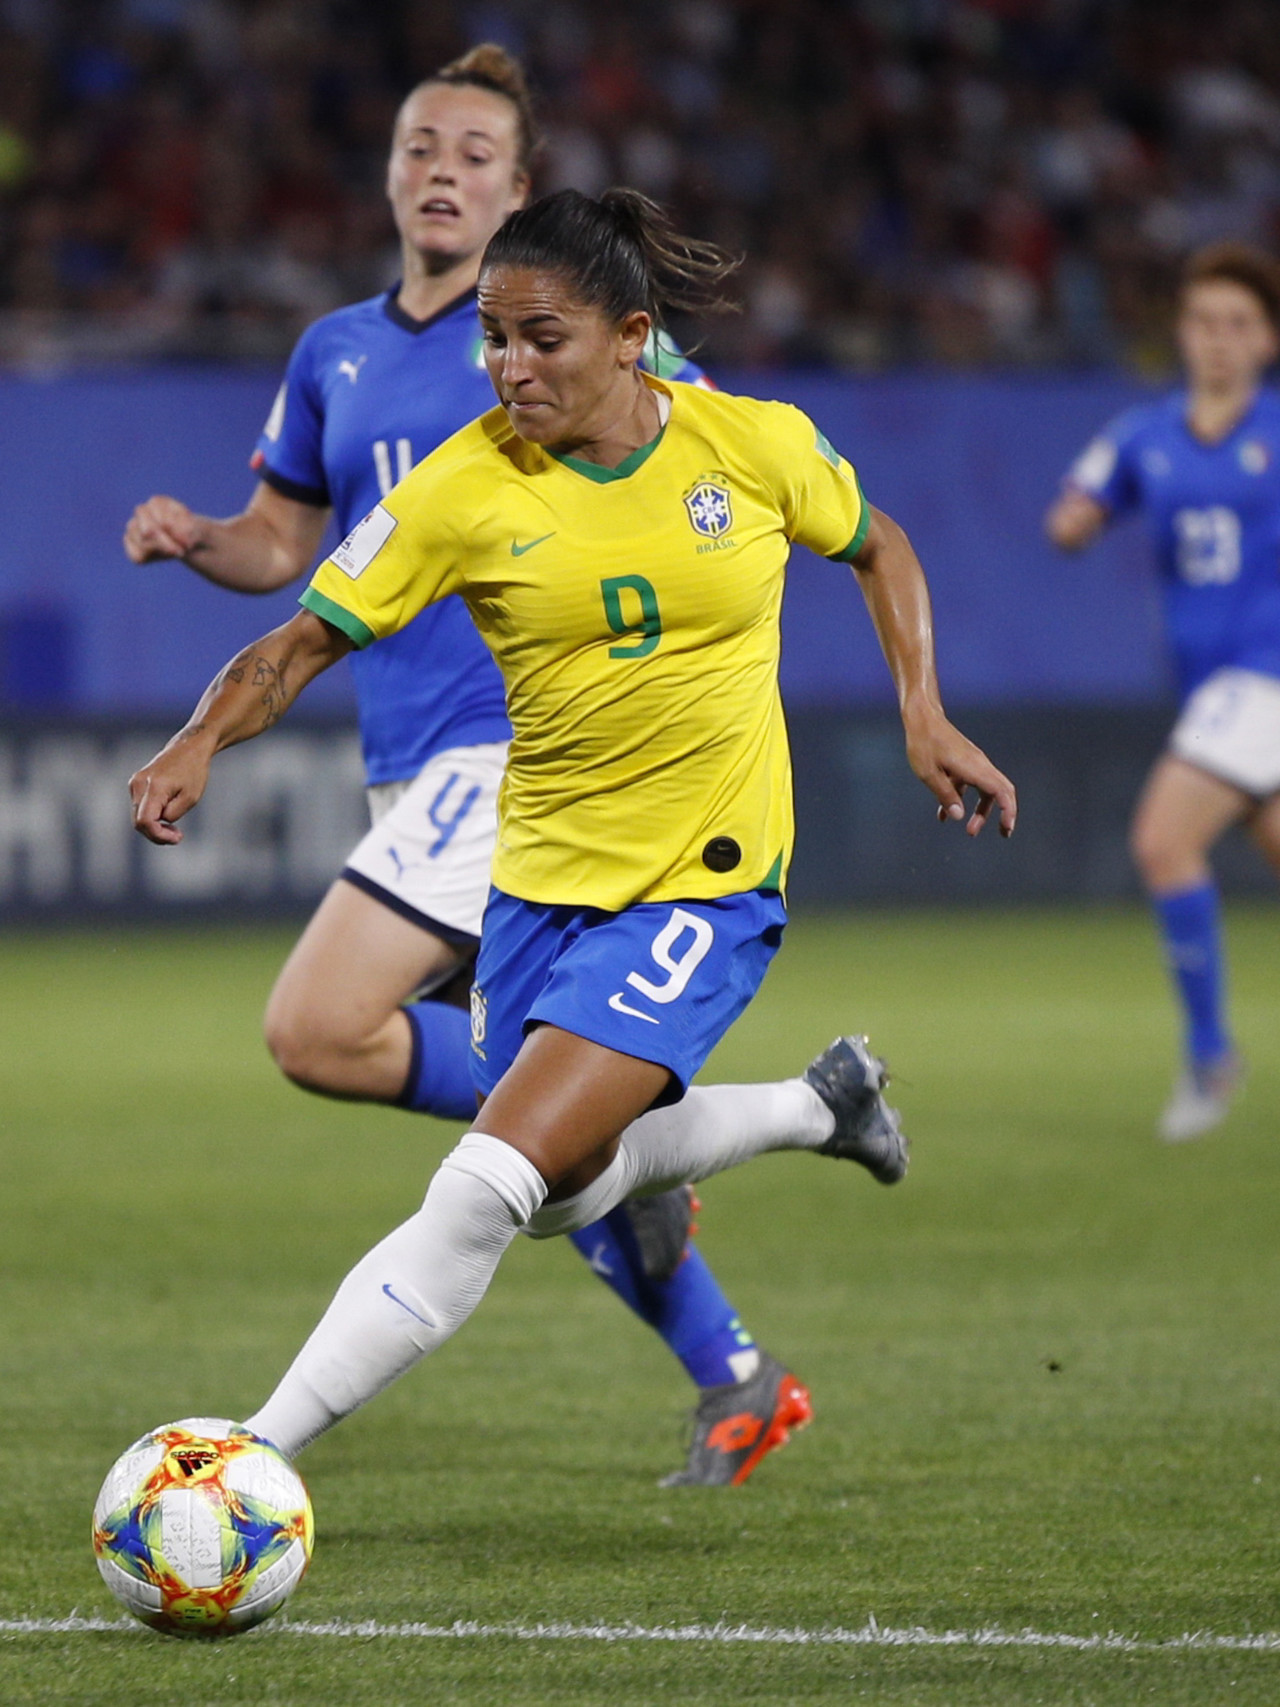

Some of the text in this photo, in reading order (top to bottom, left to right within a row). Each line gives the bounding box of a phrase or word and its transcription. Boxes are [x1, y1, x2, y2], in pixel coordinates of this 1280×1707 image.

[696, 539, 738, 554] BRASIL
[600, 574, 662, 659] 9
[426, 772, 482, 859] 4
[625, 907, 714, 1004] 9
